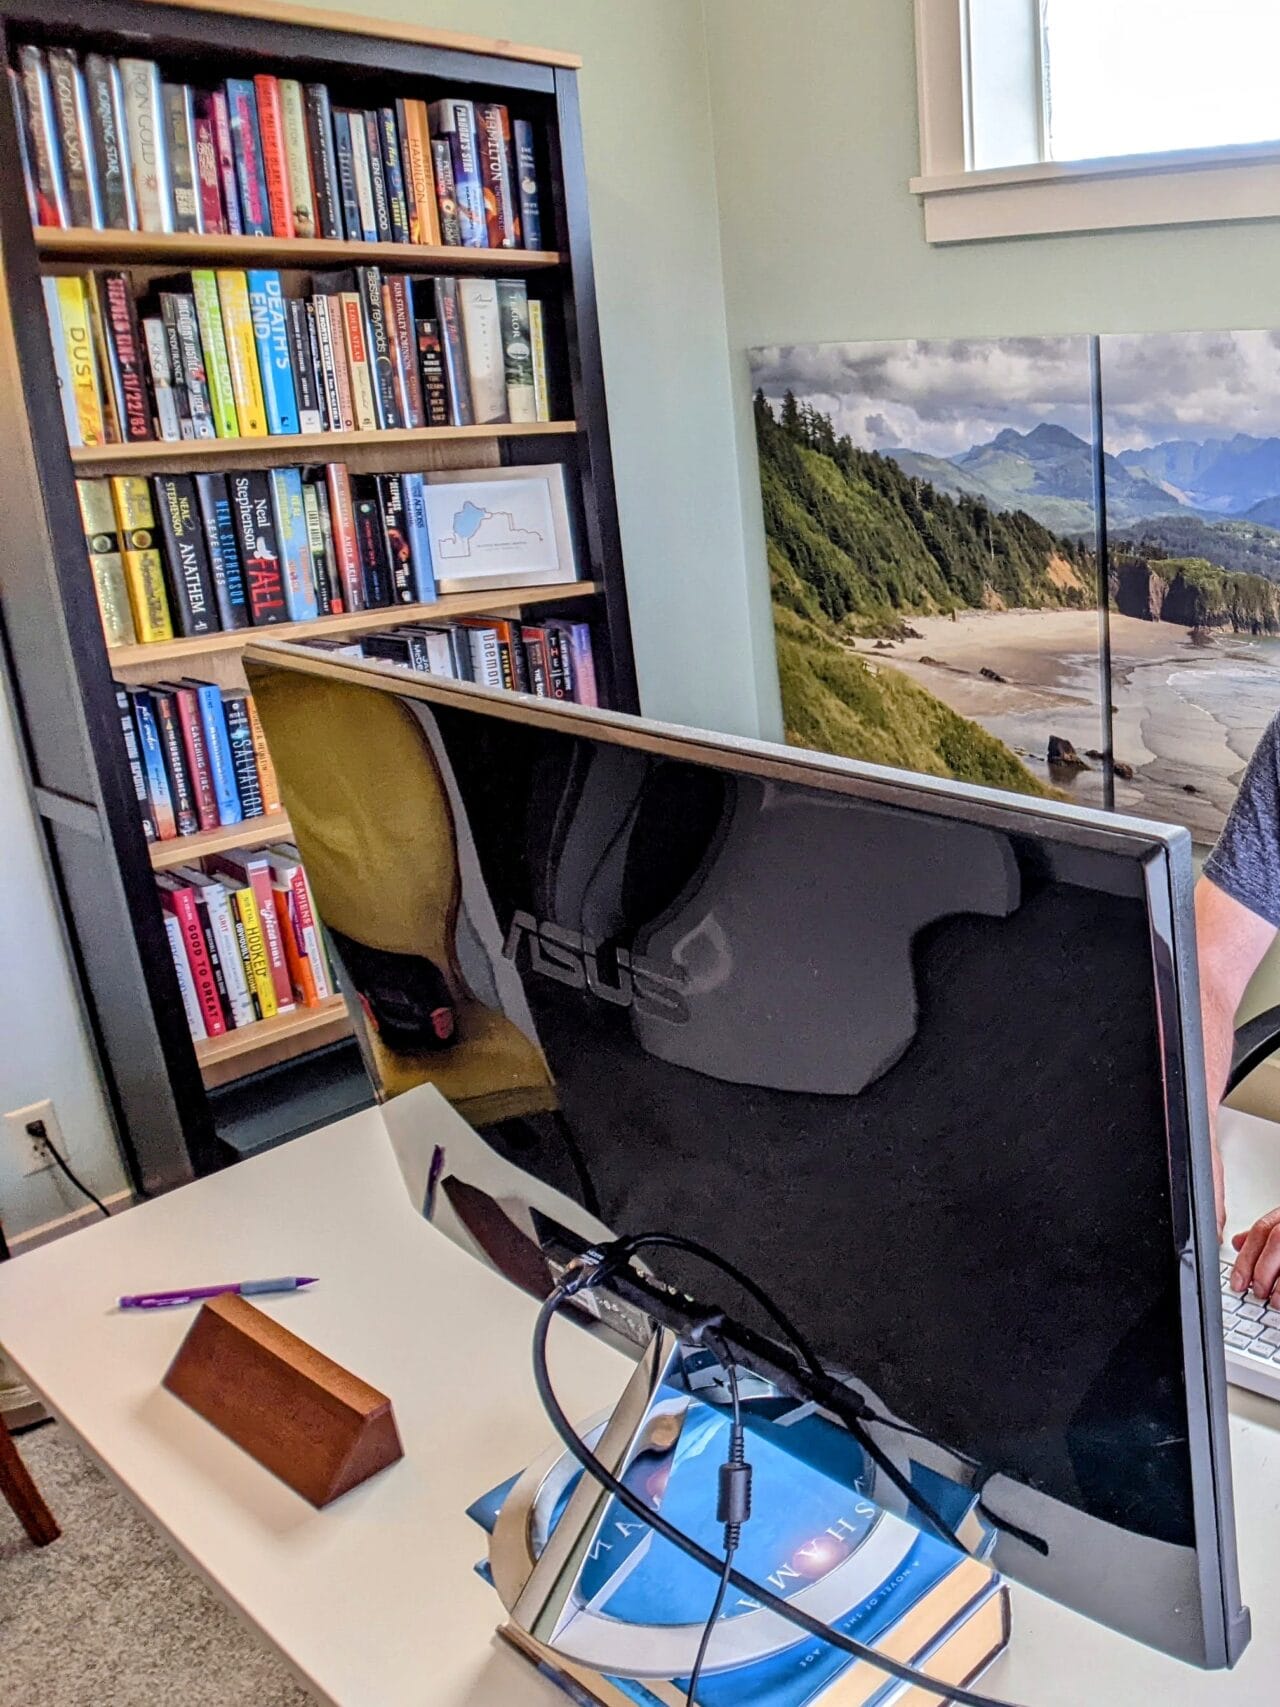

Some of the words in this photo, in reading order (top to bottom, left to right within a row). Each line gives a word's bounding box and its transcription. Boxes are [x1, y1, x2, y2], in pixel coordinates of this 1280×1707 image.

[56, 73, 76, 134] GOLDEN
[95, 80, 115, 144] MORNING
[64, 133, 83, 170] SON
[137, 113, 156, 165] GOLD
[383, 145, 398, 167] Haig
[482, 109, 503, 181] HAMILTON
[101, 144, 120, 178] STAR
[370, 156, 380, 175] KEN
[409, 137, 427, 204] HAMILTON
[461, 152, 474, 173] STAR
[373, 176, 387, 230] GRIMWOOD
[365, 270, 382, 305] alastair
[392, 281, 403, 298] KIM
[105, 278, 131, 332] STEPHEN
[251, 291, 271, 339] END
[315, 299, 325, 316] THE
[347, 302, 359, 332] CLOUD
[394, 297, 407, 330] STANLEY
[264, 279, 291, 370] DEATH'S
[318, 316, 328, 343] NORTH
[368, 307, 388, 353] reynolds
[69, 326, 93, 392] DUST
[114, 333, 136, 363] KING
[148, 342, 165, 372] KING
[166, 327, 184, 384] ENDURANCE
[181, 340, 199, 371] JUSTICE
[321, 344, 332, 371] WATER
[351, 334, 362, 360] ATLAS
[398, 330, 413, 370] ROBINSON
[120, 371, 148, 436] 11/22/63
[163, 481, 185, 536] STEPHENSON
[177, 496, 191, 520] NEAL
[213, 499, 232, 528] NEAL
[231, 477, 259, 551] Stephenson
[253, 497, 270, 527] Neal
[307, 509, 320, 528] EARTH
[413, 497, 425, 529] ACROSS
[205, 517, 226, 585] SEVENEVES
[343, 535, 352, 558] ANDY
[177, 541, 207, 614] ANATHEM
[219, 532, 246, 605] STEPHENSON
[346, 561, 356, 583] WEIR
[245, 555, 286, 617] FALL
[482, 633, 500, 686] Daemon
[500, 649, 510, 674] PETER
[168, 740, 181, 773] HUNGER
[190, 725, 205, 769] CATCHING
[198, 770, 209, 791] FIRE
[174, 772, 187, 798] GAMES
[232, 737, 263, 818] SALVATION
[293, 879, 312, 926] SAPIENS
[187, 923, 203, 957] GOOD
[217, 913, 228, 933] GRIT
[259, 905, 279, 942] pizza
[269, 939, 282, 968] BIBLE
[196, 960, 208, 977] TO
[235, 921, 250, 960] OBVIOUSLY
[243, 959, 257, 995] AWESOME
[246, 925, 268, 979] HOOKED
[501, 909, 691, 1027] ASUS
[201, 980, 218, 1019] GREAT
[882, 1569, 911, 1597] NOVEL
[843, 1609, 866, 1629] THE
[865, 1597, 879, 1611] OF
[798, 1647, 821, 1668] AGE
